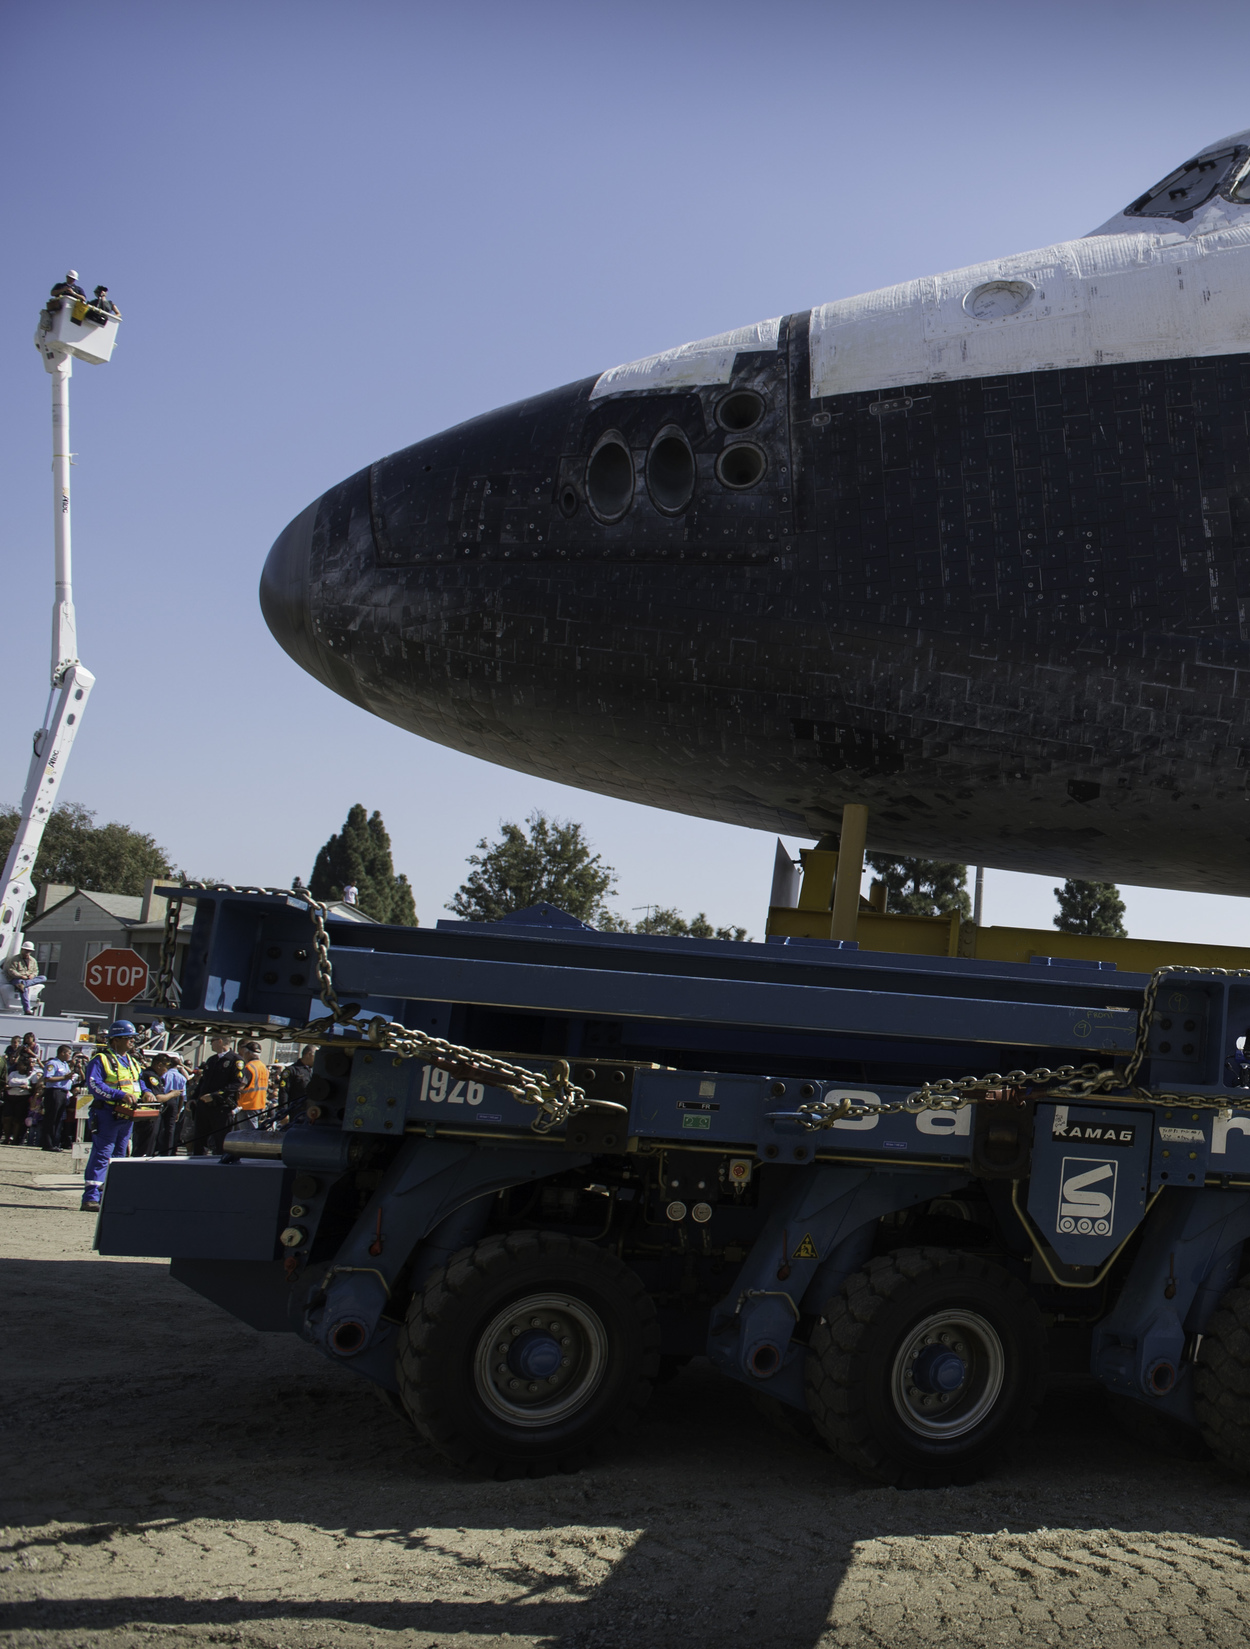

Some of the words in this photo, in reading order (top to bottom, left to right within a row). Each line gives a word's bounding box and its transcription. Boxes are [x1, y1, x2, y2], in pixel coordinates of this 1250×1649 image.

[48, 749, 59, 768] Altec
[89, 965, 145, 987] STOP
[419, 1065, 485, 1106] 1926
[1054, 1126, 1133, 1142] KAMAG
